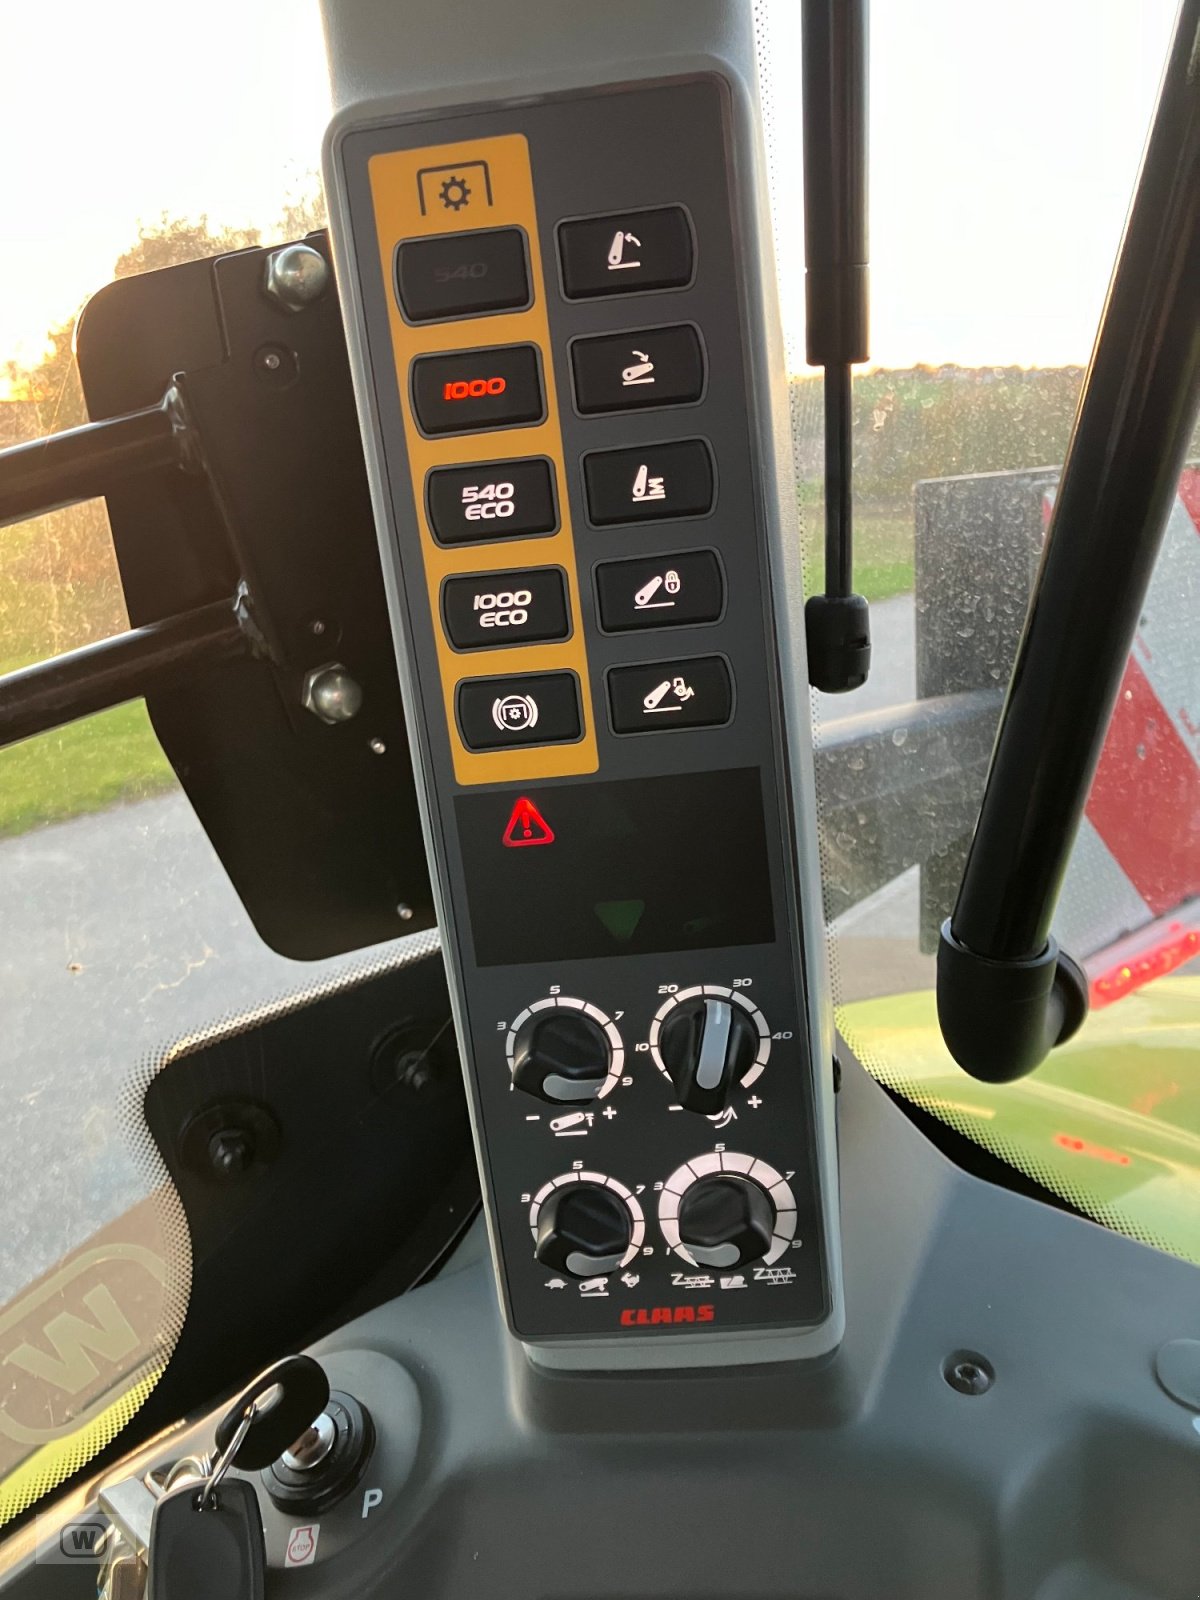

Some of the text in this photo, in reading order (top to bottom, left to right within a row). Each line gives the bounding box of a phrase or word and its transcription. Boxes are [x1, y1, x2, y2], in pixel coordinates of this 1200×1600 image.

[432, 262, 489, 283] 540
[443, 376, 507, 401] 1000
[461, 482, 515, 504] 540
[464, 500, 515, 522] ECO
[473, 589, 532, 611] 1000
[479, 608, 528, 628] ECO
[732, 977, 753, 988] 30
[549, 984, 561, 995] 5
[657, 983, 679, 995] 20
[614, 1010, 625, 1021] 7
[496, 1020, 507, 1031] 3
[771, 1030, 793, 1040] 40
[634, 1042, 650, 1052] 10
[621, 1076, 634, 1087] 9
[714, 1142, 726, 1153] 5
[572, 1160, 584, 1170] 5
[785, 1170, 796, 1181] 7
[635, 1184, 646, 1195] 7
[652, 1181, 664, 1191] 3
[520, 1193, 531, 1203] 3
[791, 1239, 803, 1249] 9
[642, 1246, 654, 1256] 9
[619, 1304, 715, 1327] CLAAS
[361, 1488, 384, 1519] P
